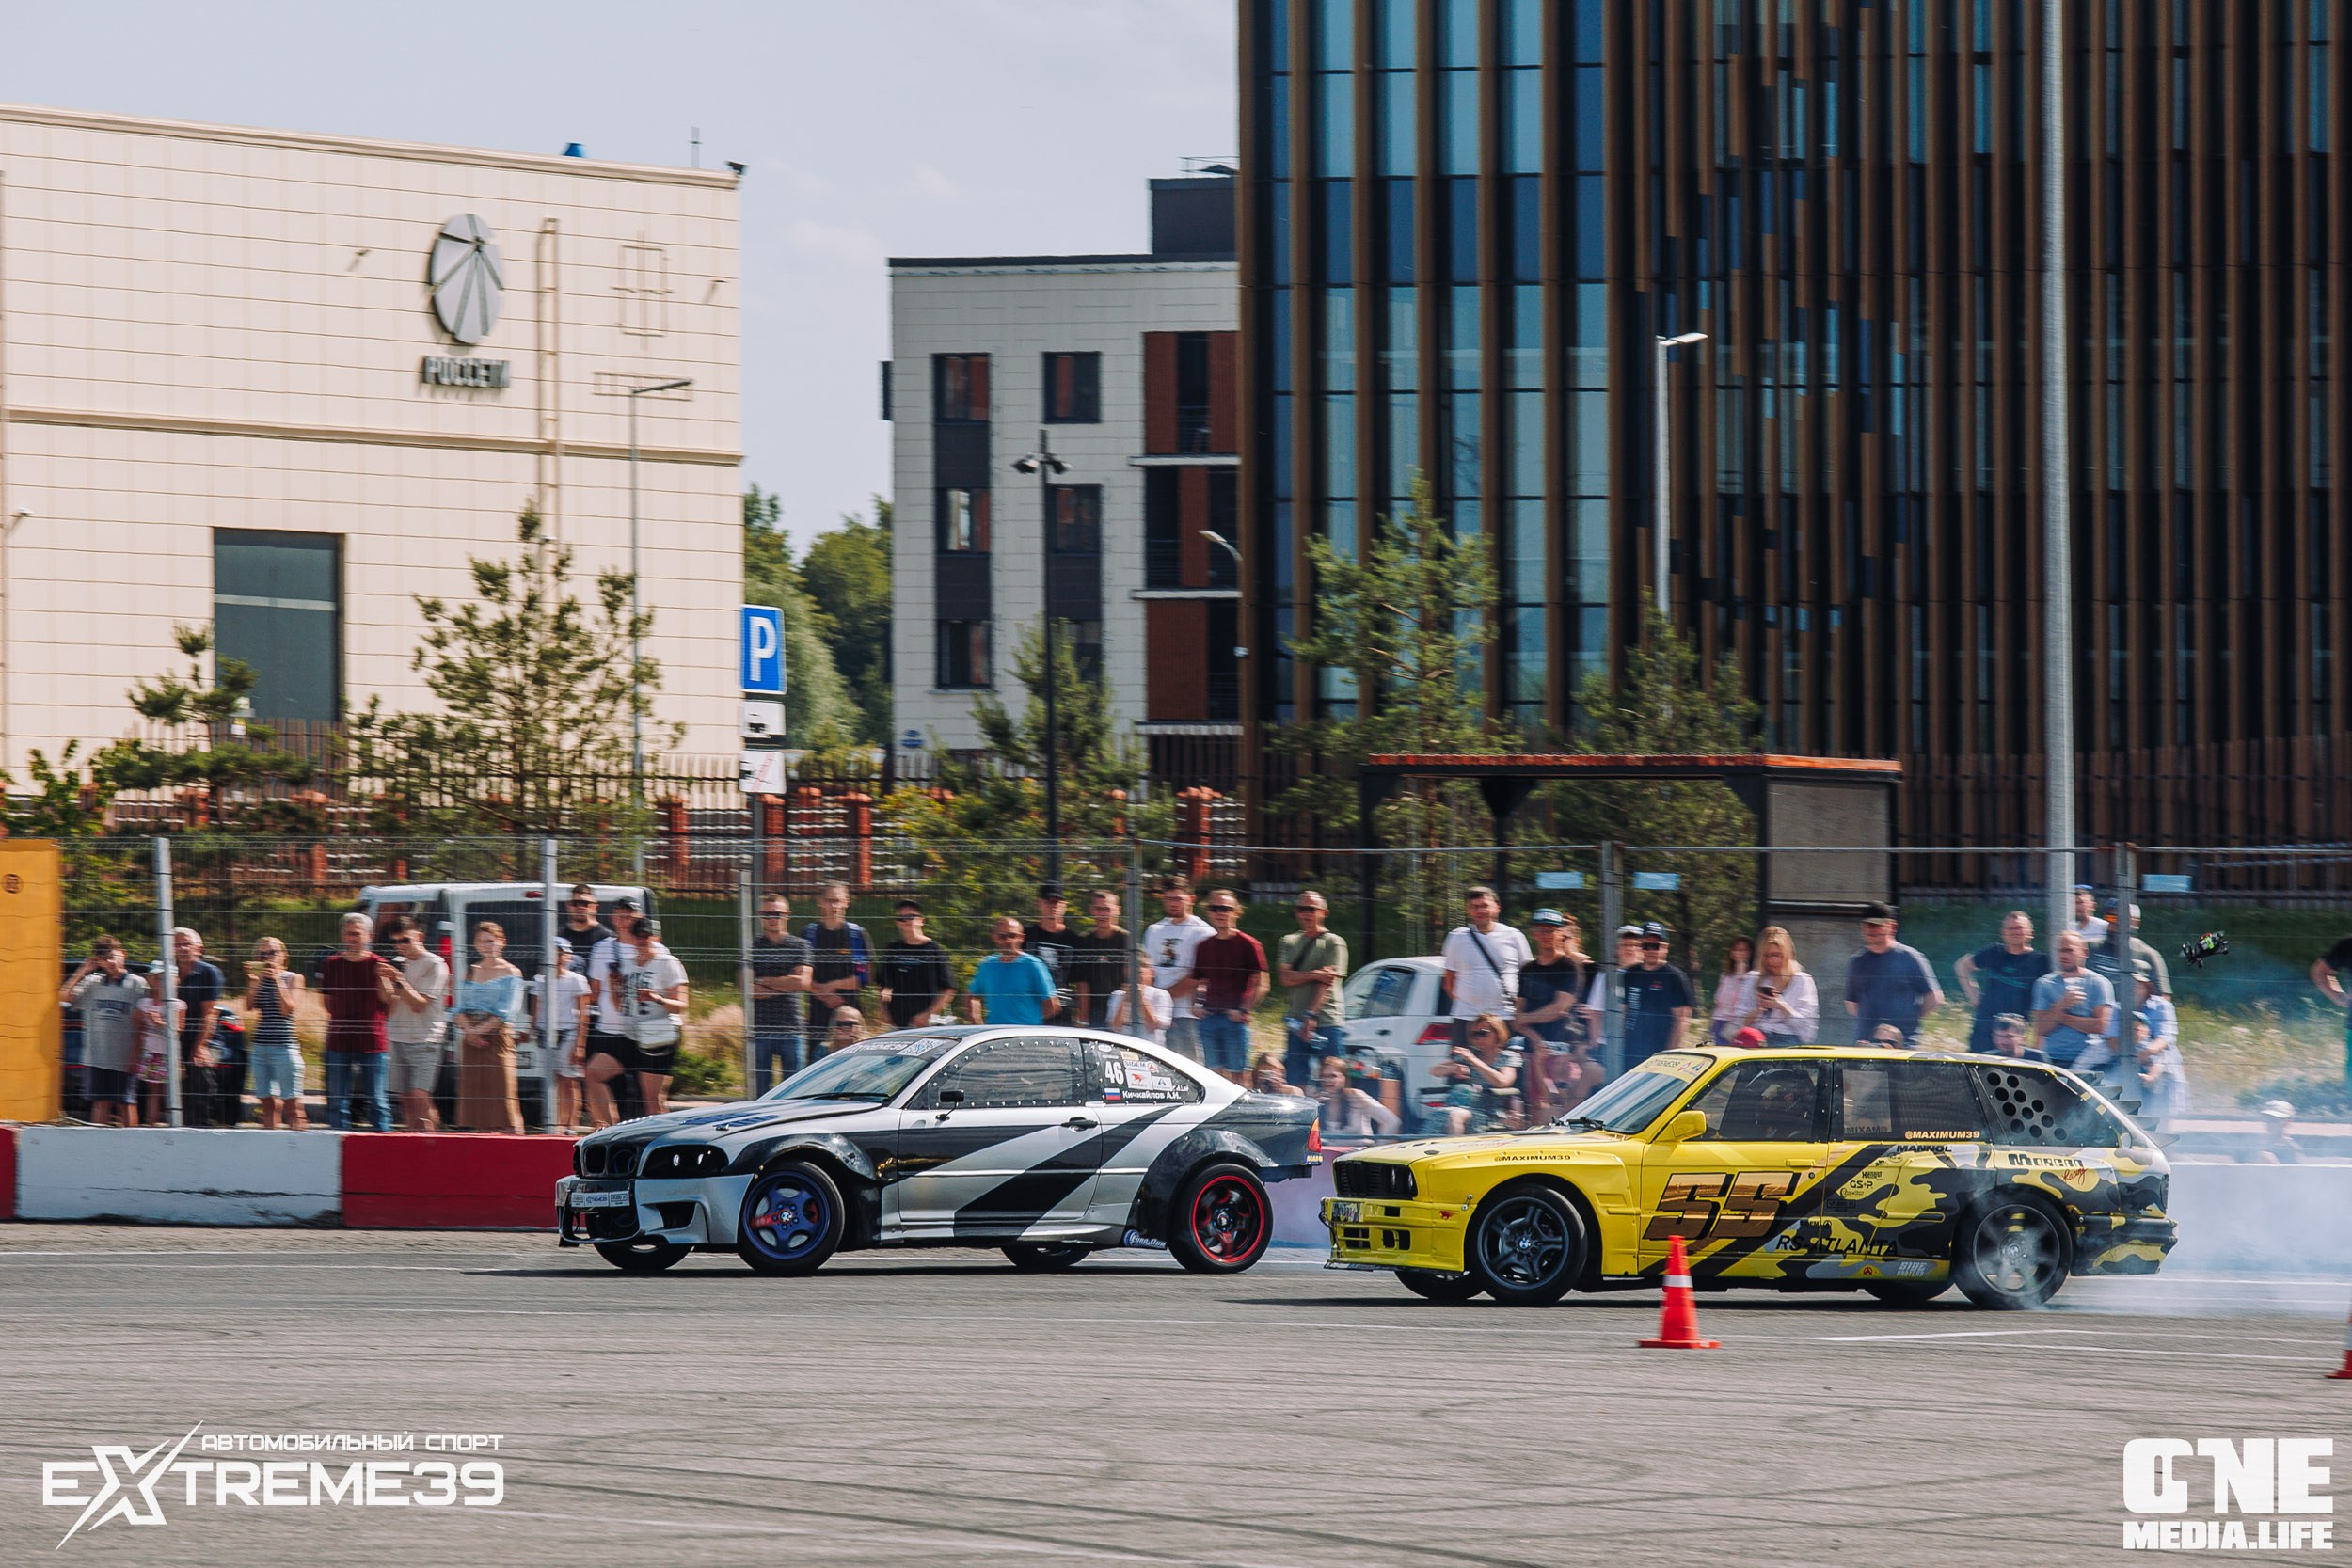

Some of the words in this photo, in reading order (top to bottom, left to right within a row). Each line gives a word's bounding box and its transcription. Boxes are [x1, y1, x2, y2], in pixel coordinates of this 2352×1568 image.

[750, 616, 776, 681] P
[1104, 1061, 1125, 1085] 46
[1121, 1090, 1166, 1100] Кичкайлов
[1904, 1130, 1980, 1140] @MAXIMUM39
[1896, 1145, 1953, 1153] MANNOL
